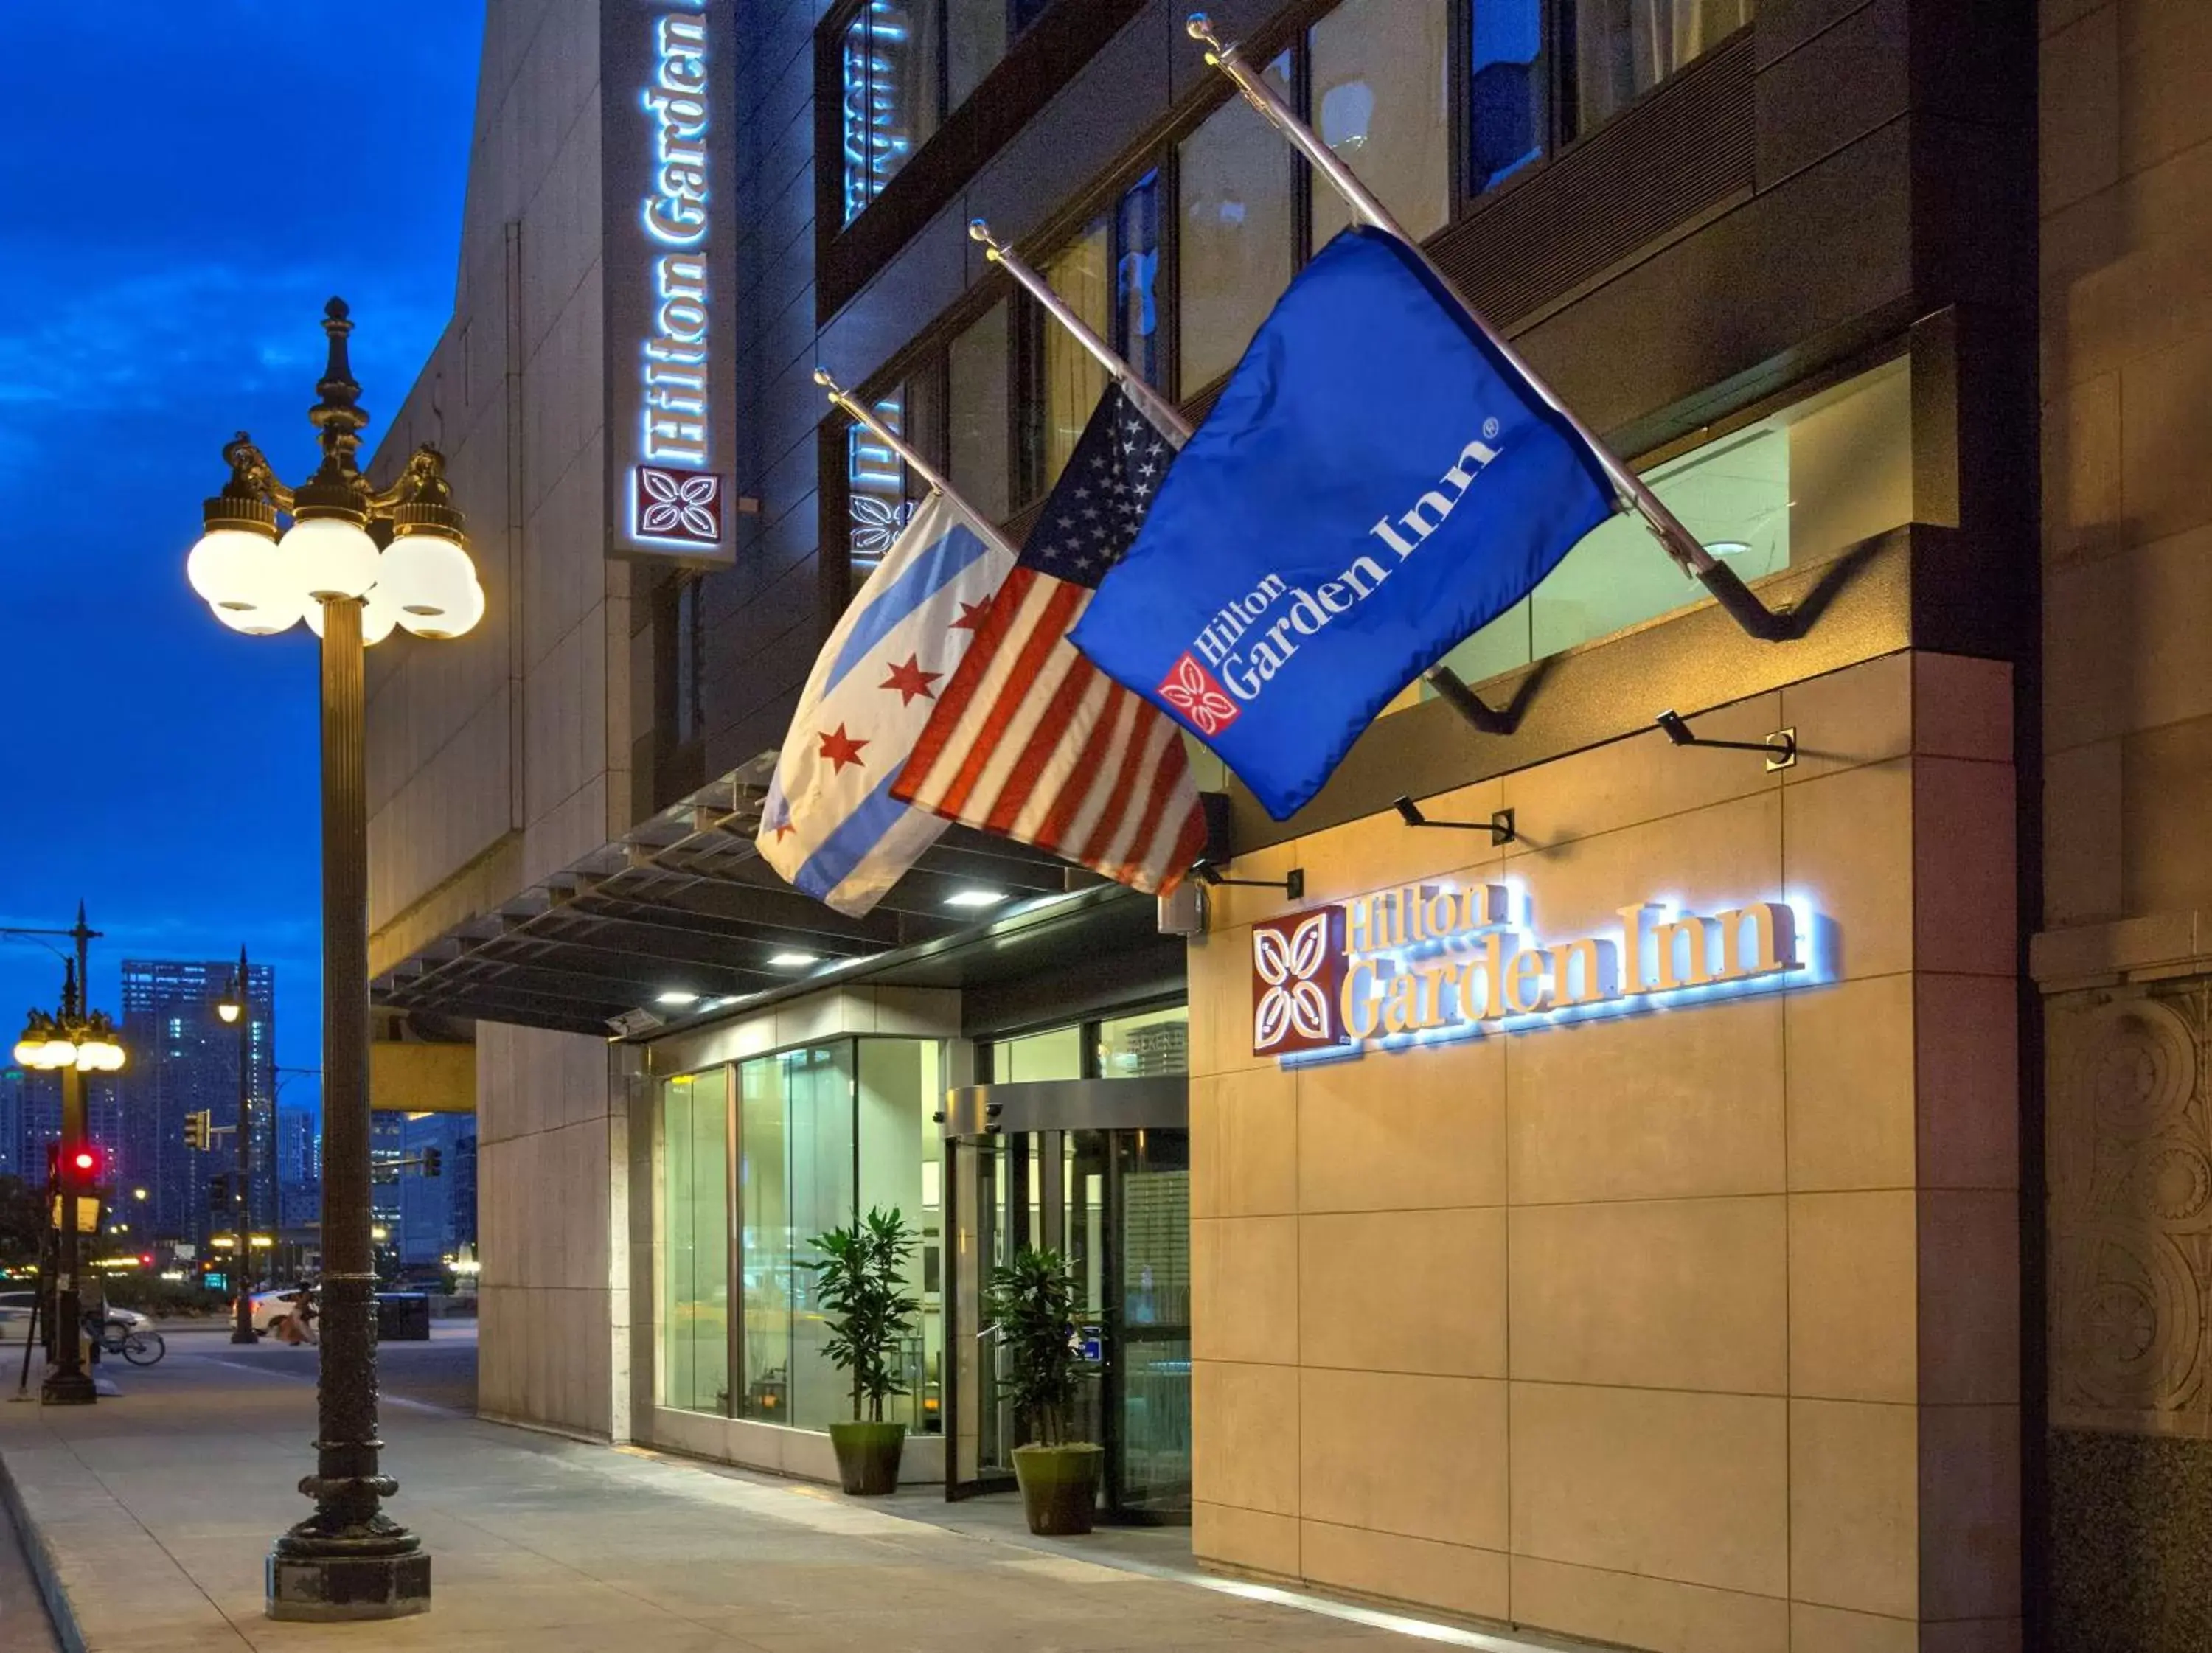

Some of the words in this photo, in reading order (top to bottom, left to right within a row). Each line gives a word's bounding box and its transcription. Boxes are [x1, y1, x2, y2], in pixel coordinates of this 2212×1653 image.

[644, 13, 707, 243] Garden
[646, 252, 707, 462] Hilton
[1194, 574, 1287, 667] Hilton
[1222, 554, 1393, 700] Garden
[1340, 933, 1619, 1039] Garden
[1617, 902, 1806, 995] Inn
[1342, 883, 1512, 956] Hilton
